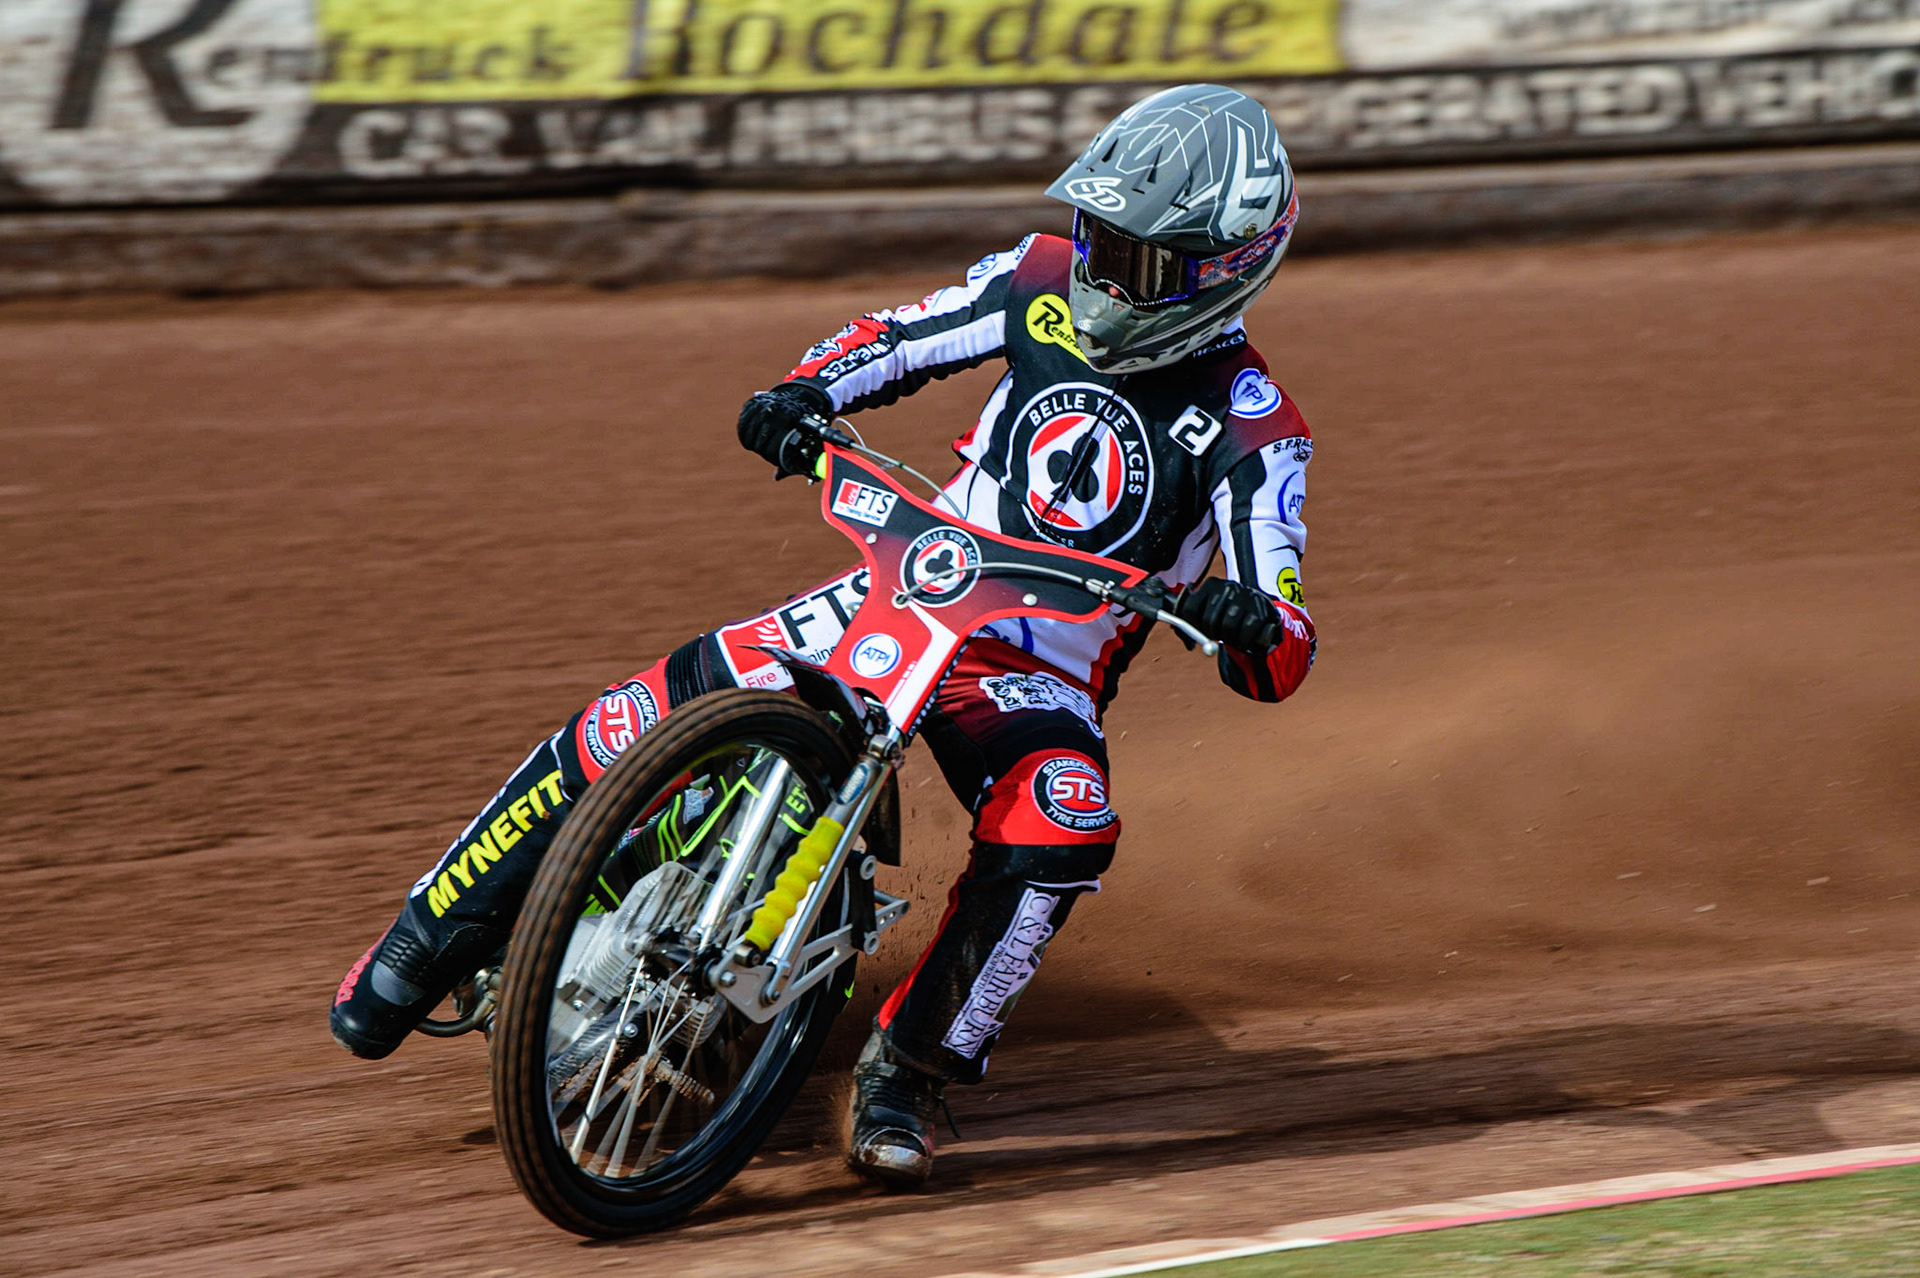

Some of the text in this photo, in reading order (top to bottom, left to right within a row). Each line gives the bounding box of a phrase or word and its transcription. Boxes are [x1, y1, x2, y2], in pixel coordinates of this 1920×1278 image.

[1027, 392, 1145, 497] BELLE VUE ACES
[1173, 409, 1214, 452] 2
[854, 486, 893, 515] FTS
[915, 531, 978, 567] BELLE VUE ACE
[859, 646, 892, 666] ATPI
[745, 671, 777, 688] Fire
[604, 693, 637, 754] STS
[1051, 776, 1106, 804] STS
[1045, 805, 1075, 826] TYRE
[427, 769, 564, 918] MYNEFIT
